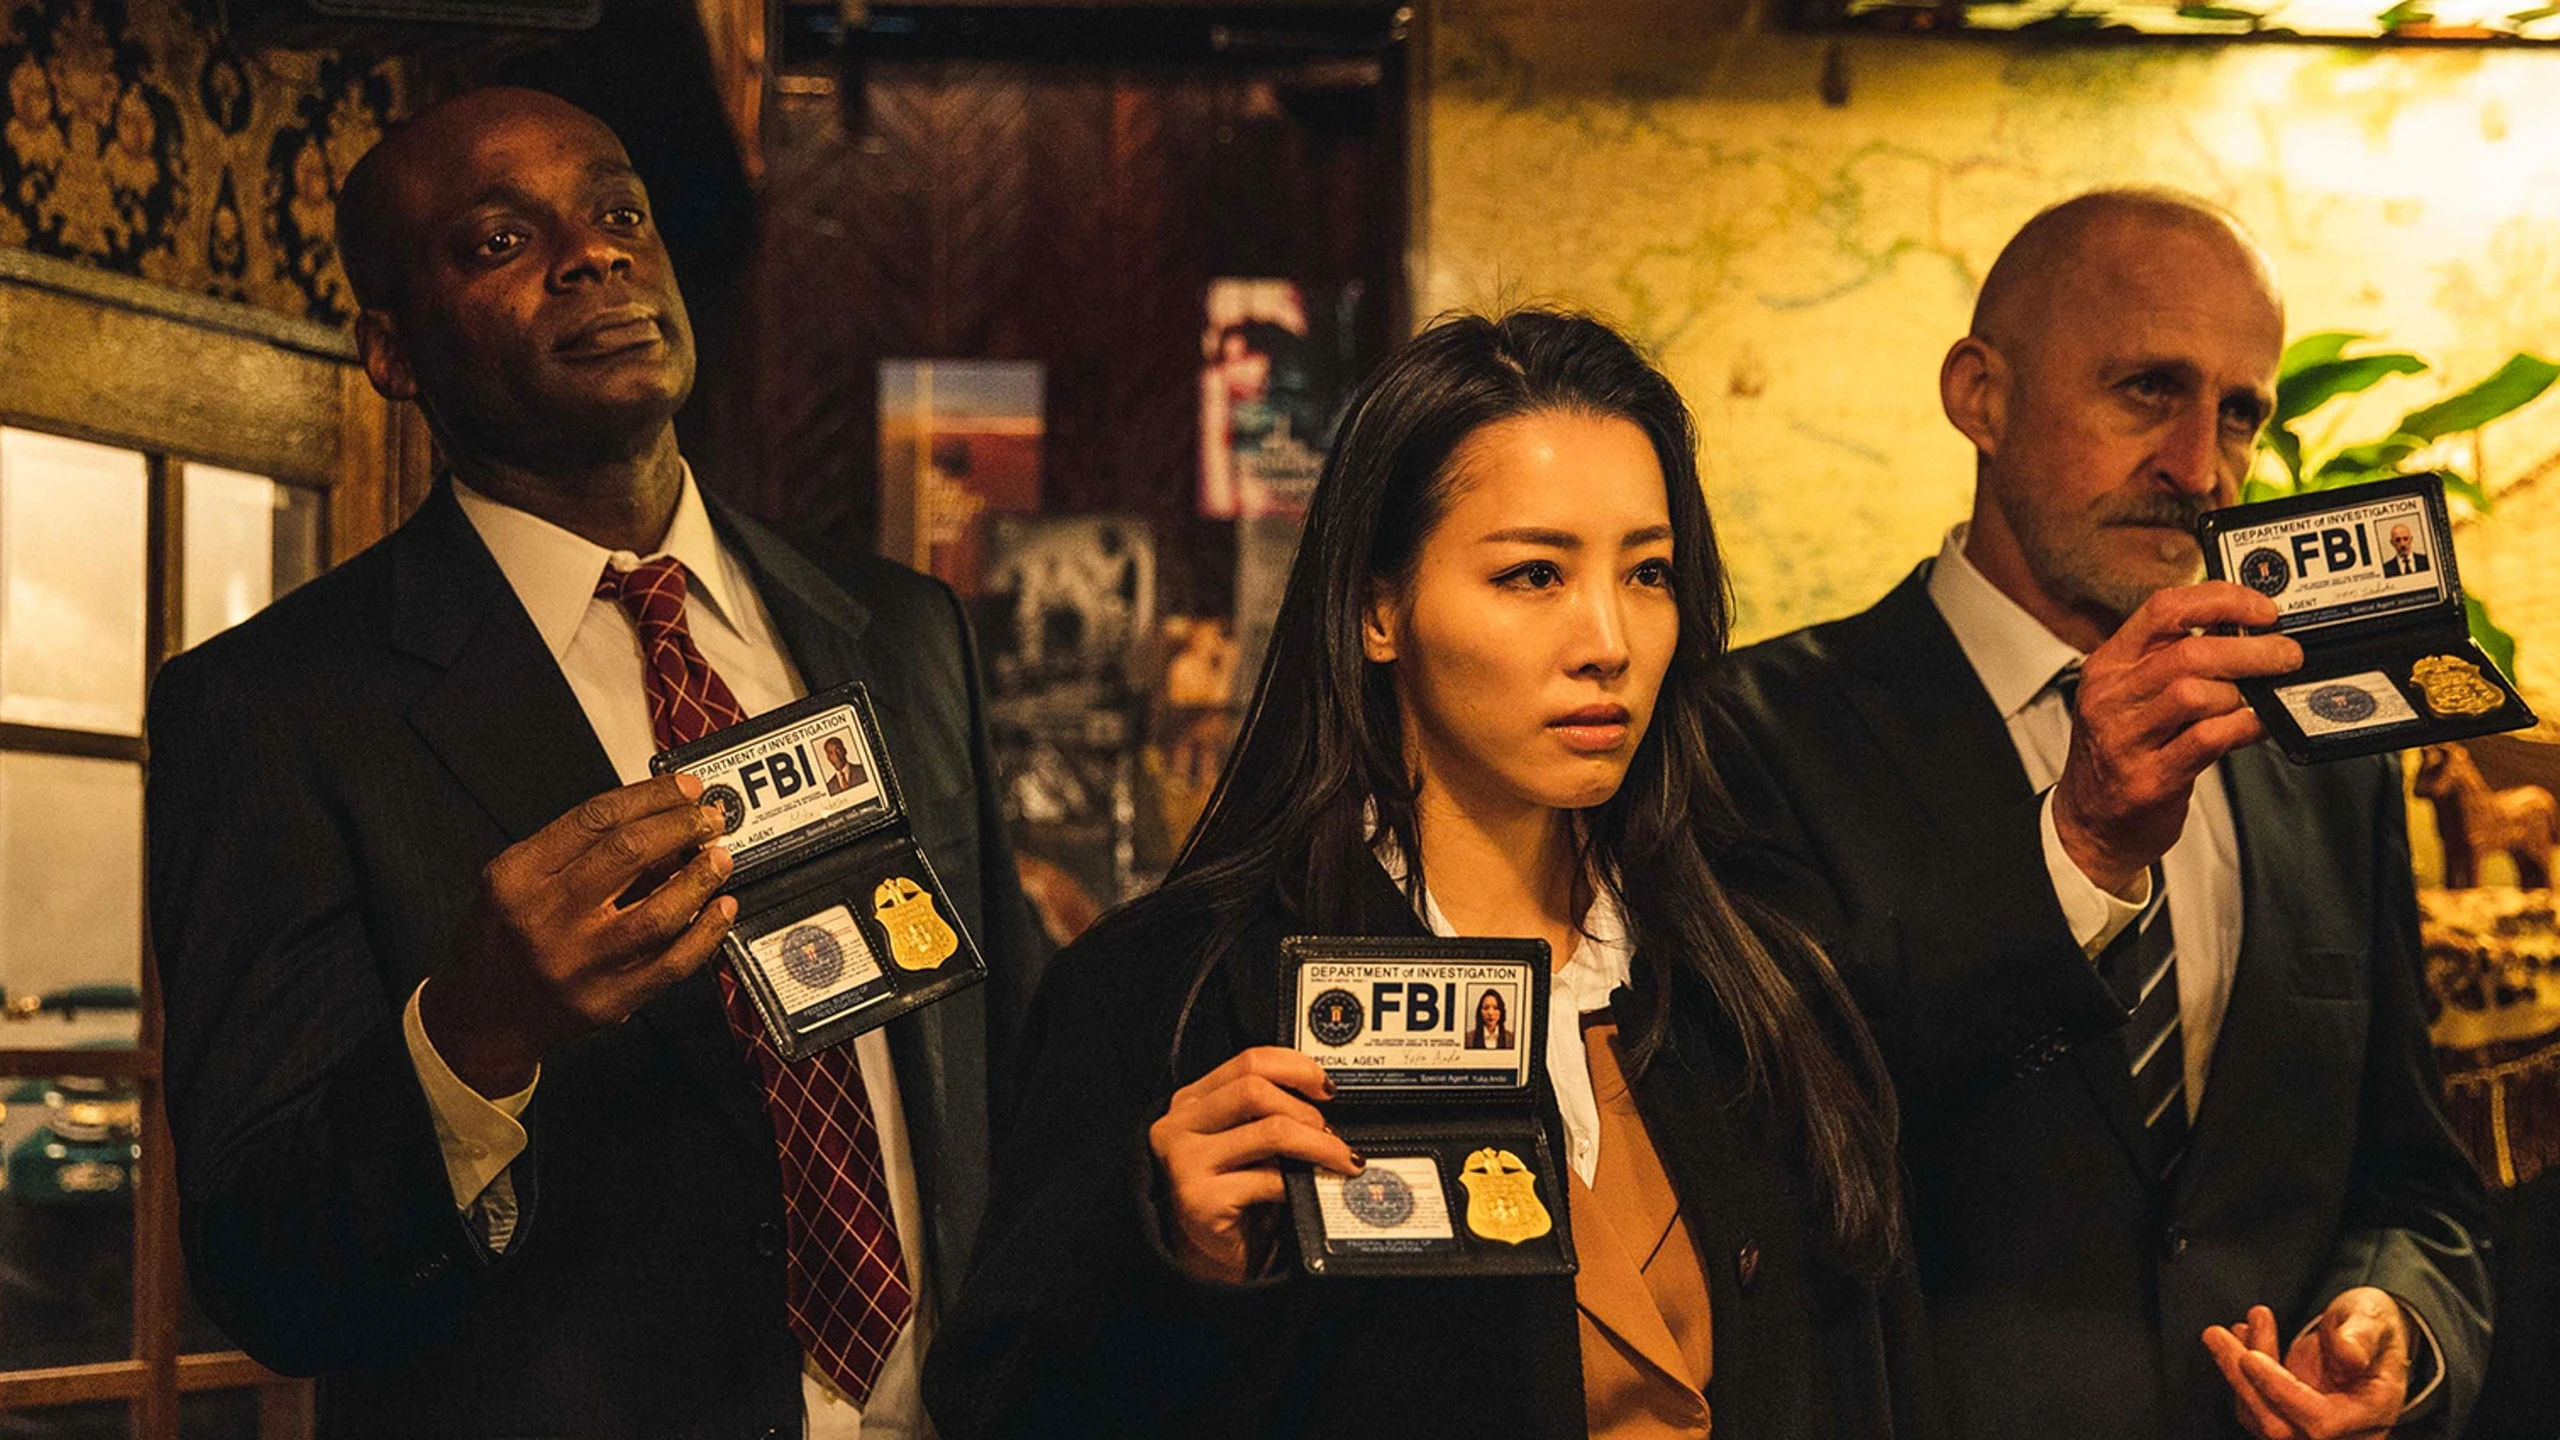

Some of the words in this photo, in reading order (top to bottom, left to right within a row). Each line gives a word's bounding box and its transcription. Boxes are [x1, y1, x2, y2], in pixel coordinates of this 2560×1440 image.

[2233, 519, 2312, 543] DEPARTMENT
[2313, 518, 2325, 528] of
[2326, 501, 2417, 525] INVESTIGATION
[2290, 523, 2373, 579] FBI
[2287, 599, 2317, 612] AGENT
[692, 749, 757, 778] EPARTMENT
[757, 745, 768, 756] of
[767, 713, 847, 750] INVESTIGATION
[738, 744, 817, 810] FBI
[727, 841, 746, 853] CIAL
[747, 827, 775, 845] AGENT
[1310, 966, 1400, 979] DEPARTMENT
[1402, 967, 1415, 978] of
[1416, 967, 1517, 979] INVESTIGATION
[1371, 982, 1456, 1032] FBI
[1310, 1056, 1348, 1066] PECIAL
[1352, 1056, 1386, 1066] AGENT
[1420, 1074, 1446, 1083] Special
[1448, 1074, 1469, 1083] Agent
